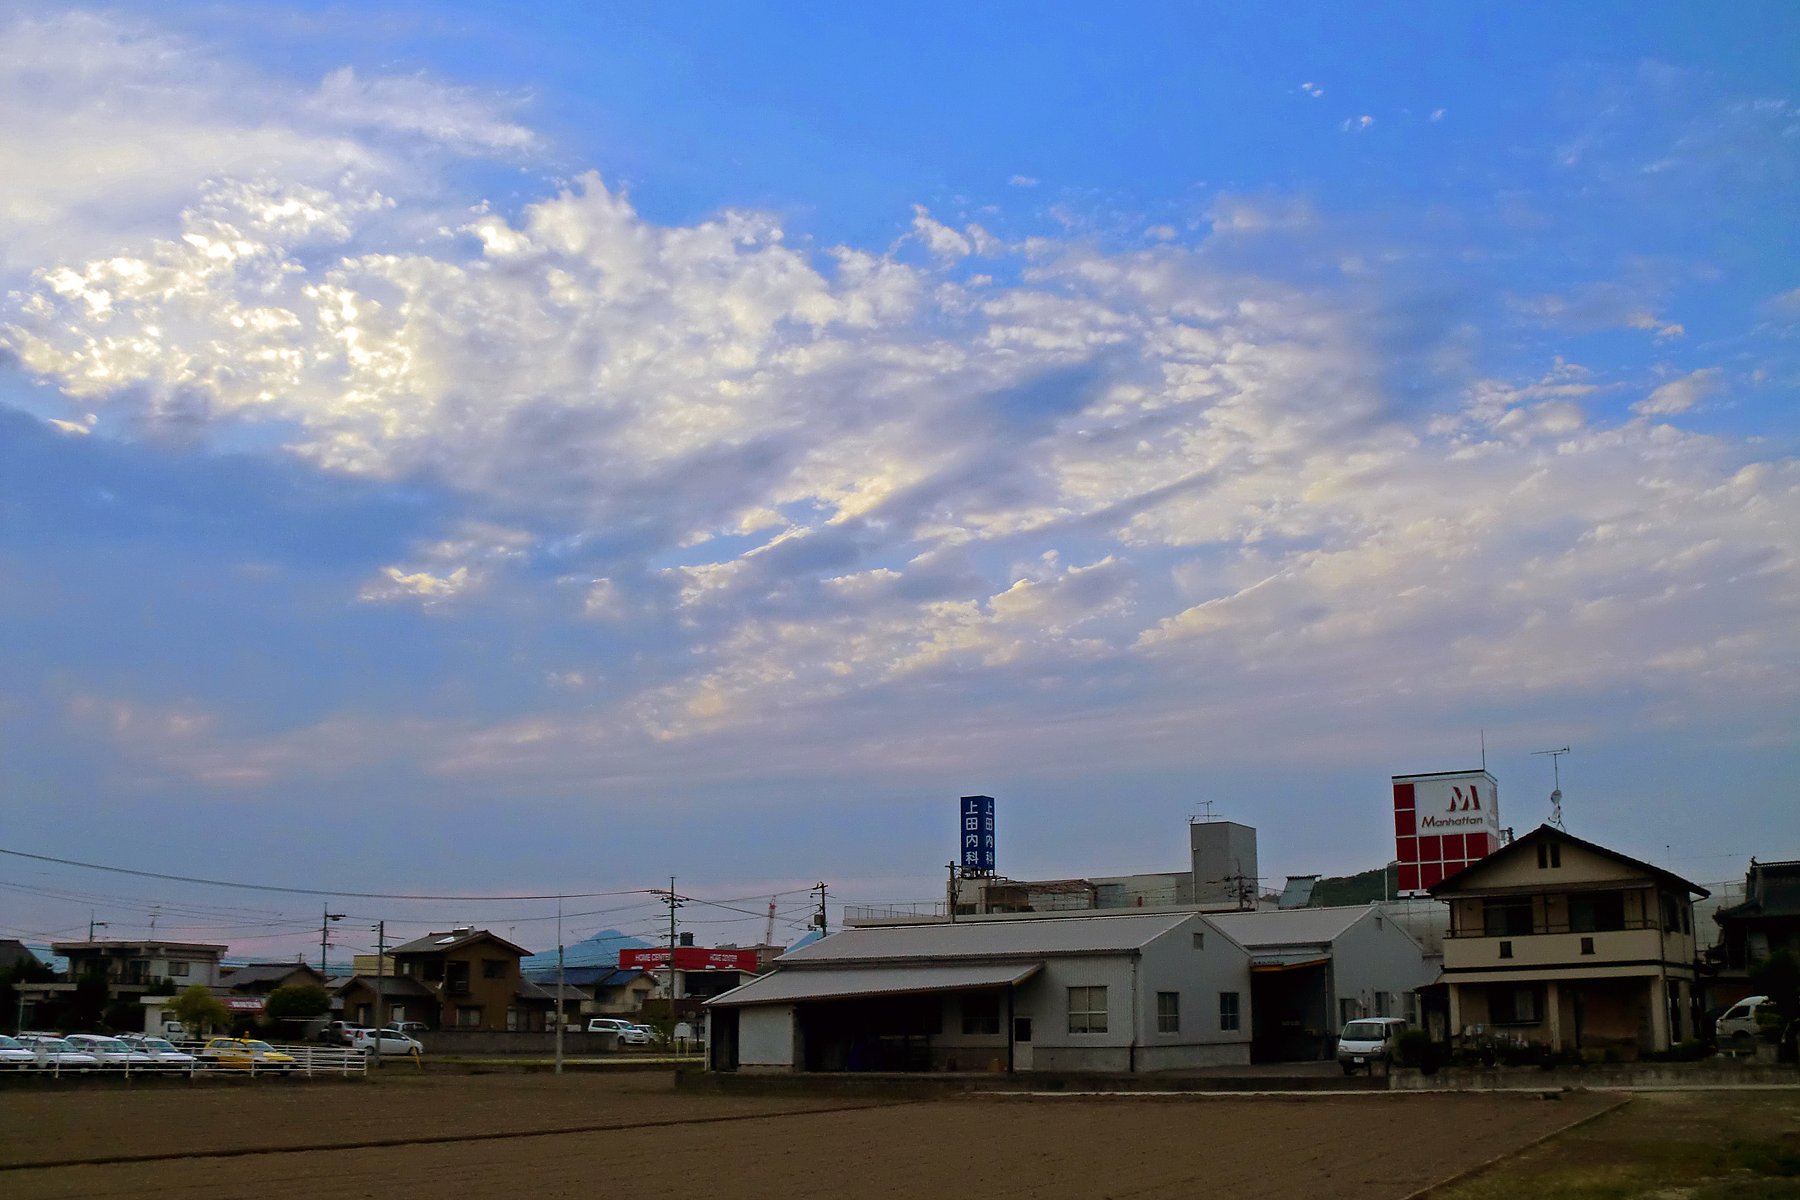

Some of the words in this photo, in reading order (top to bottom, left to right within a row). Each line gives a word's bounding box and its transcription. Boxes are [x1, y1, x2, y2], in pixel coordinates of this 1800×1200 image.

[965, 800, 979, 865] 上田内科
[985, 800, 993, 865] 上田内科
[1421, 815, 1483, 828] Manhattan
[635, 953, 651, 962] HOME
